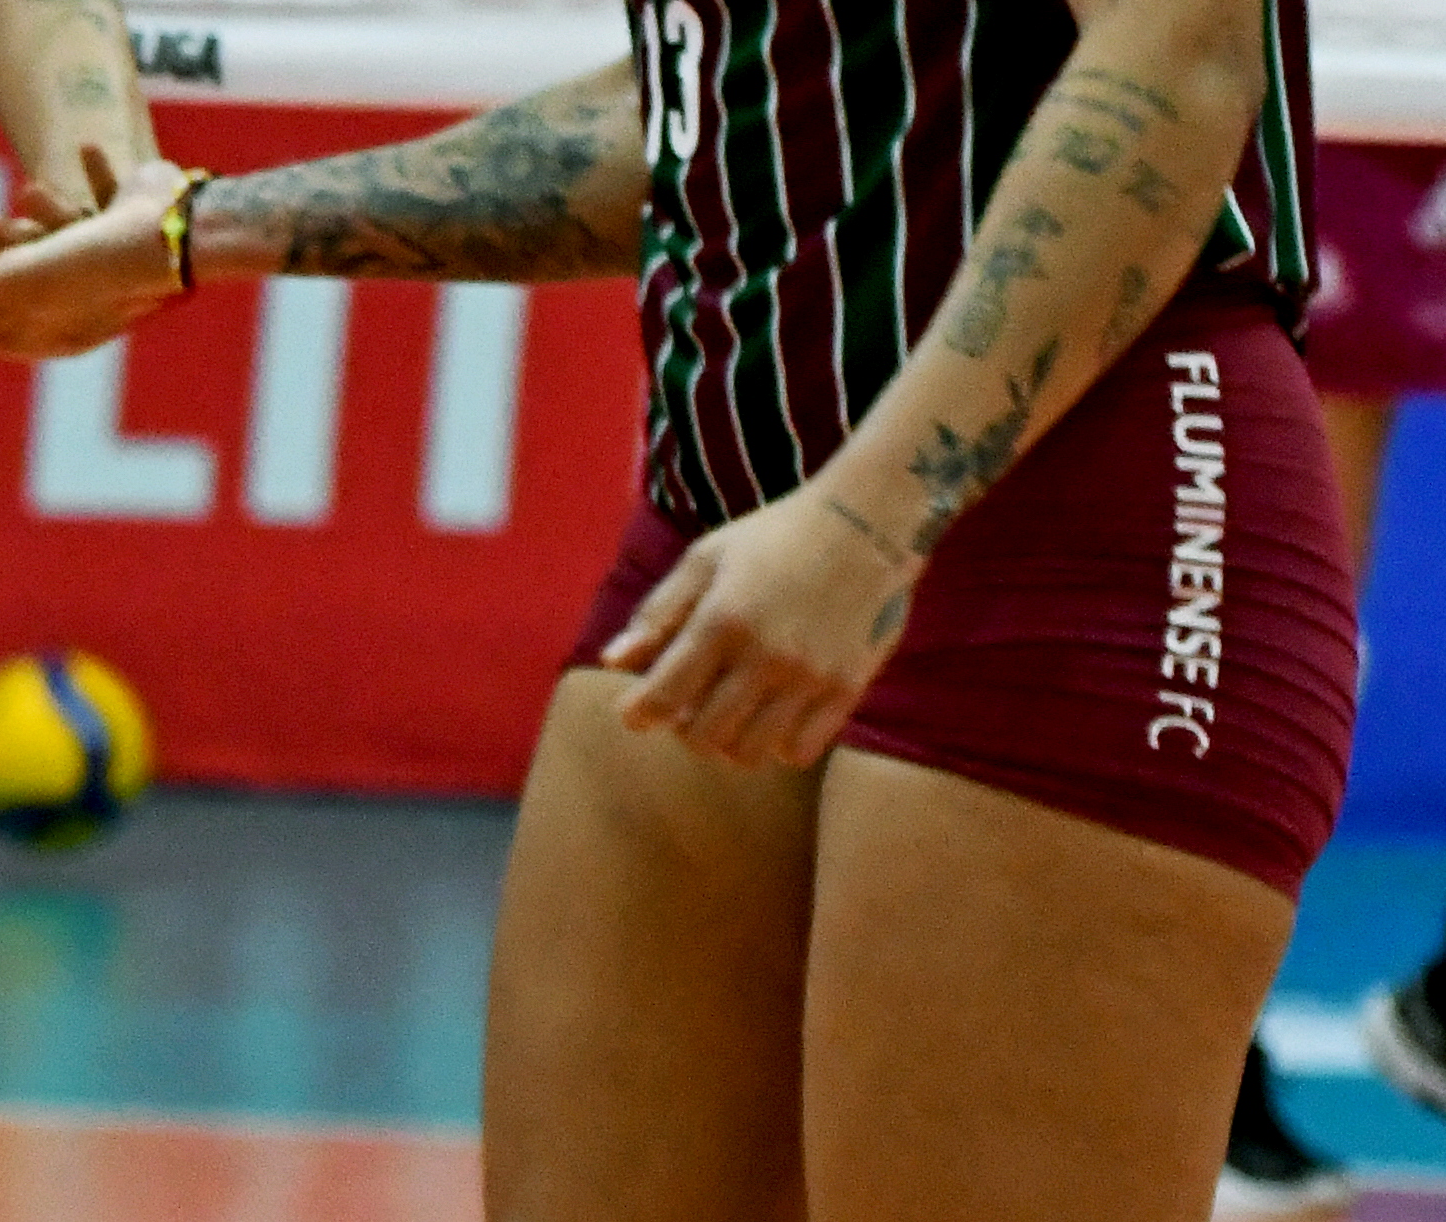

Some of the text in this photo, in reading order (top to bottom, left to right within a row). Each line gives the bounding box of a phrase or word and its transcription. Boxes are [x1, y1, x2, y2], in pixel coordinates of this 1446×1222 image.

[643, 0, 704, 168] 13
[1147, 350, 1227, 759] FLUMINENSE FC
